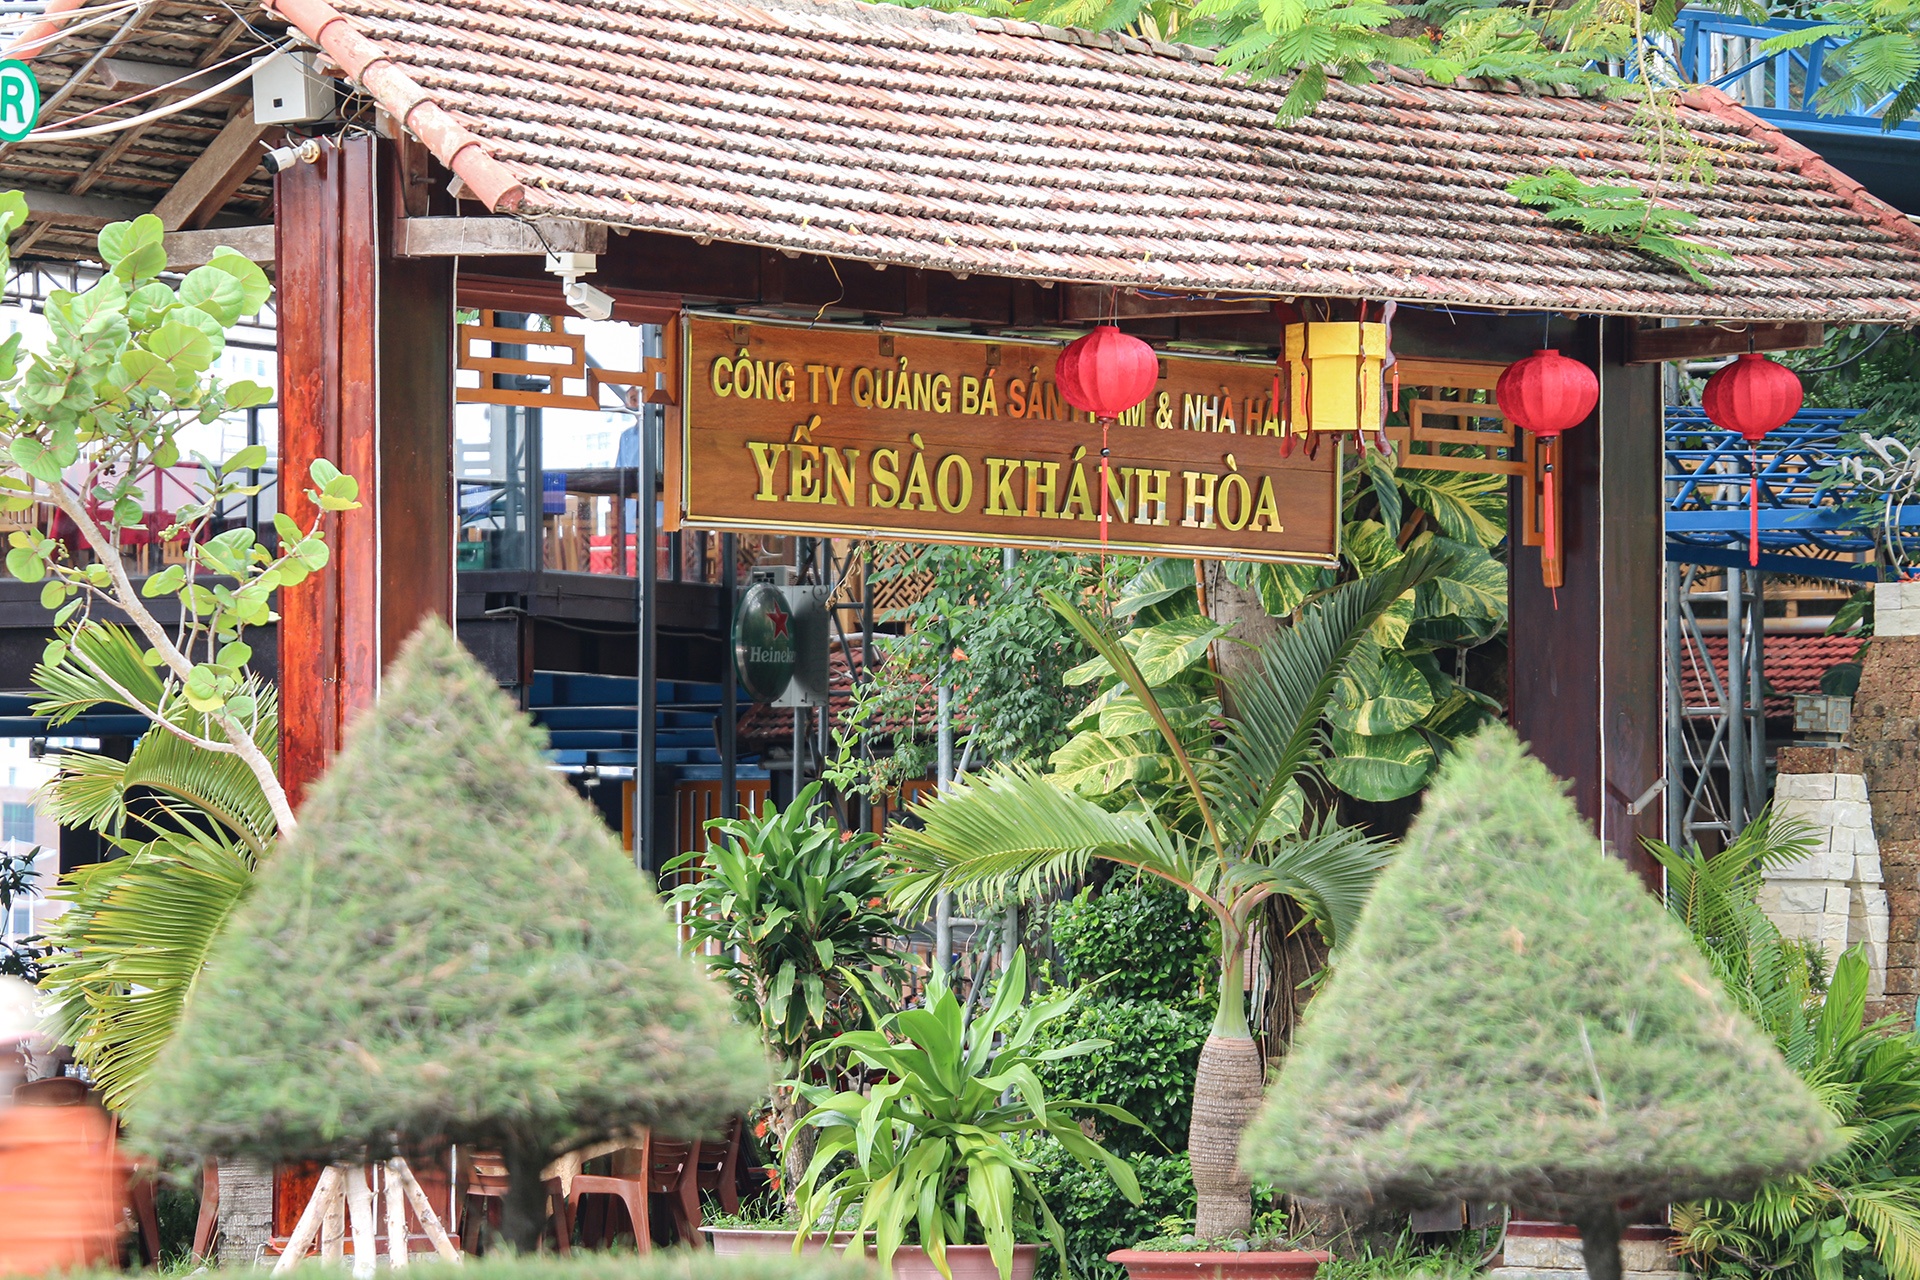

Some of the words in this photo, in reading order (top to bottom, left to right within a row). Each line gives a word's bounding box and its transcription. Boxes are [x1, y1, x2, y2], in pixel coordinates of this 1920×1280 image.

[1, 75, 25, 123] R
[711, 348, 795, 402] CÔNG
[806, 364, 844, 405] TY
[852, 356, 951, 413] QUẢNG
[960, 369, 999, 416] BÁ
[1007, 366, 1063, 420] SẢN
[1156, 391, 1174, 429] &
[1183, 386, 1236, 434] NHÀ
[1244, 389, 1307, 440] HÀ
[746, 415, 860, 507] YẾN
[869, 433, 974, 514] SÀO
[982, 445, 1170, 526] KHÁNH
[1180, 453, 1284, 533] HÒA
